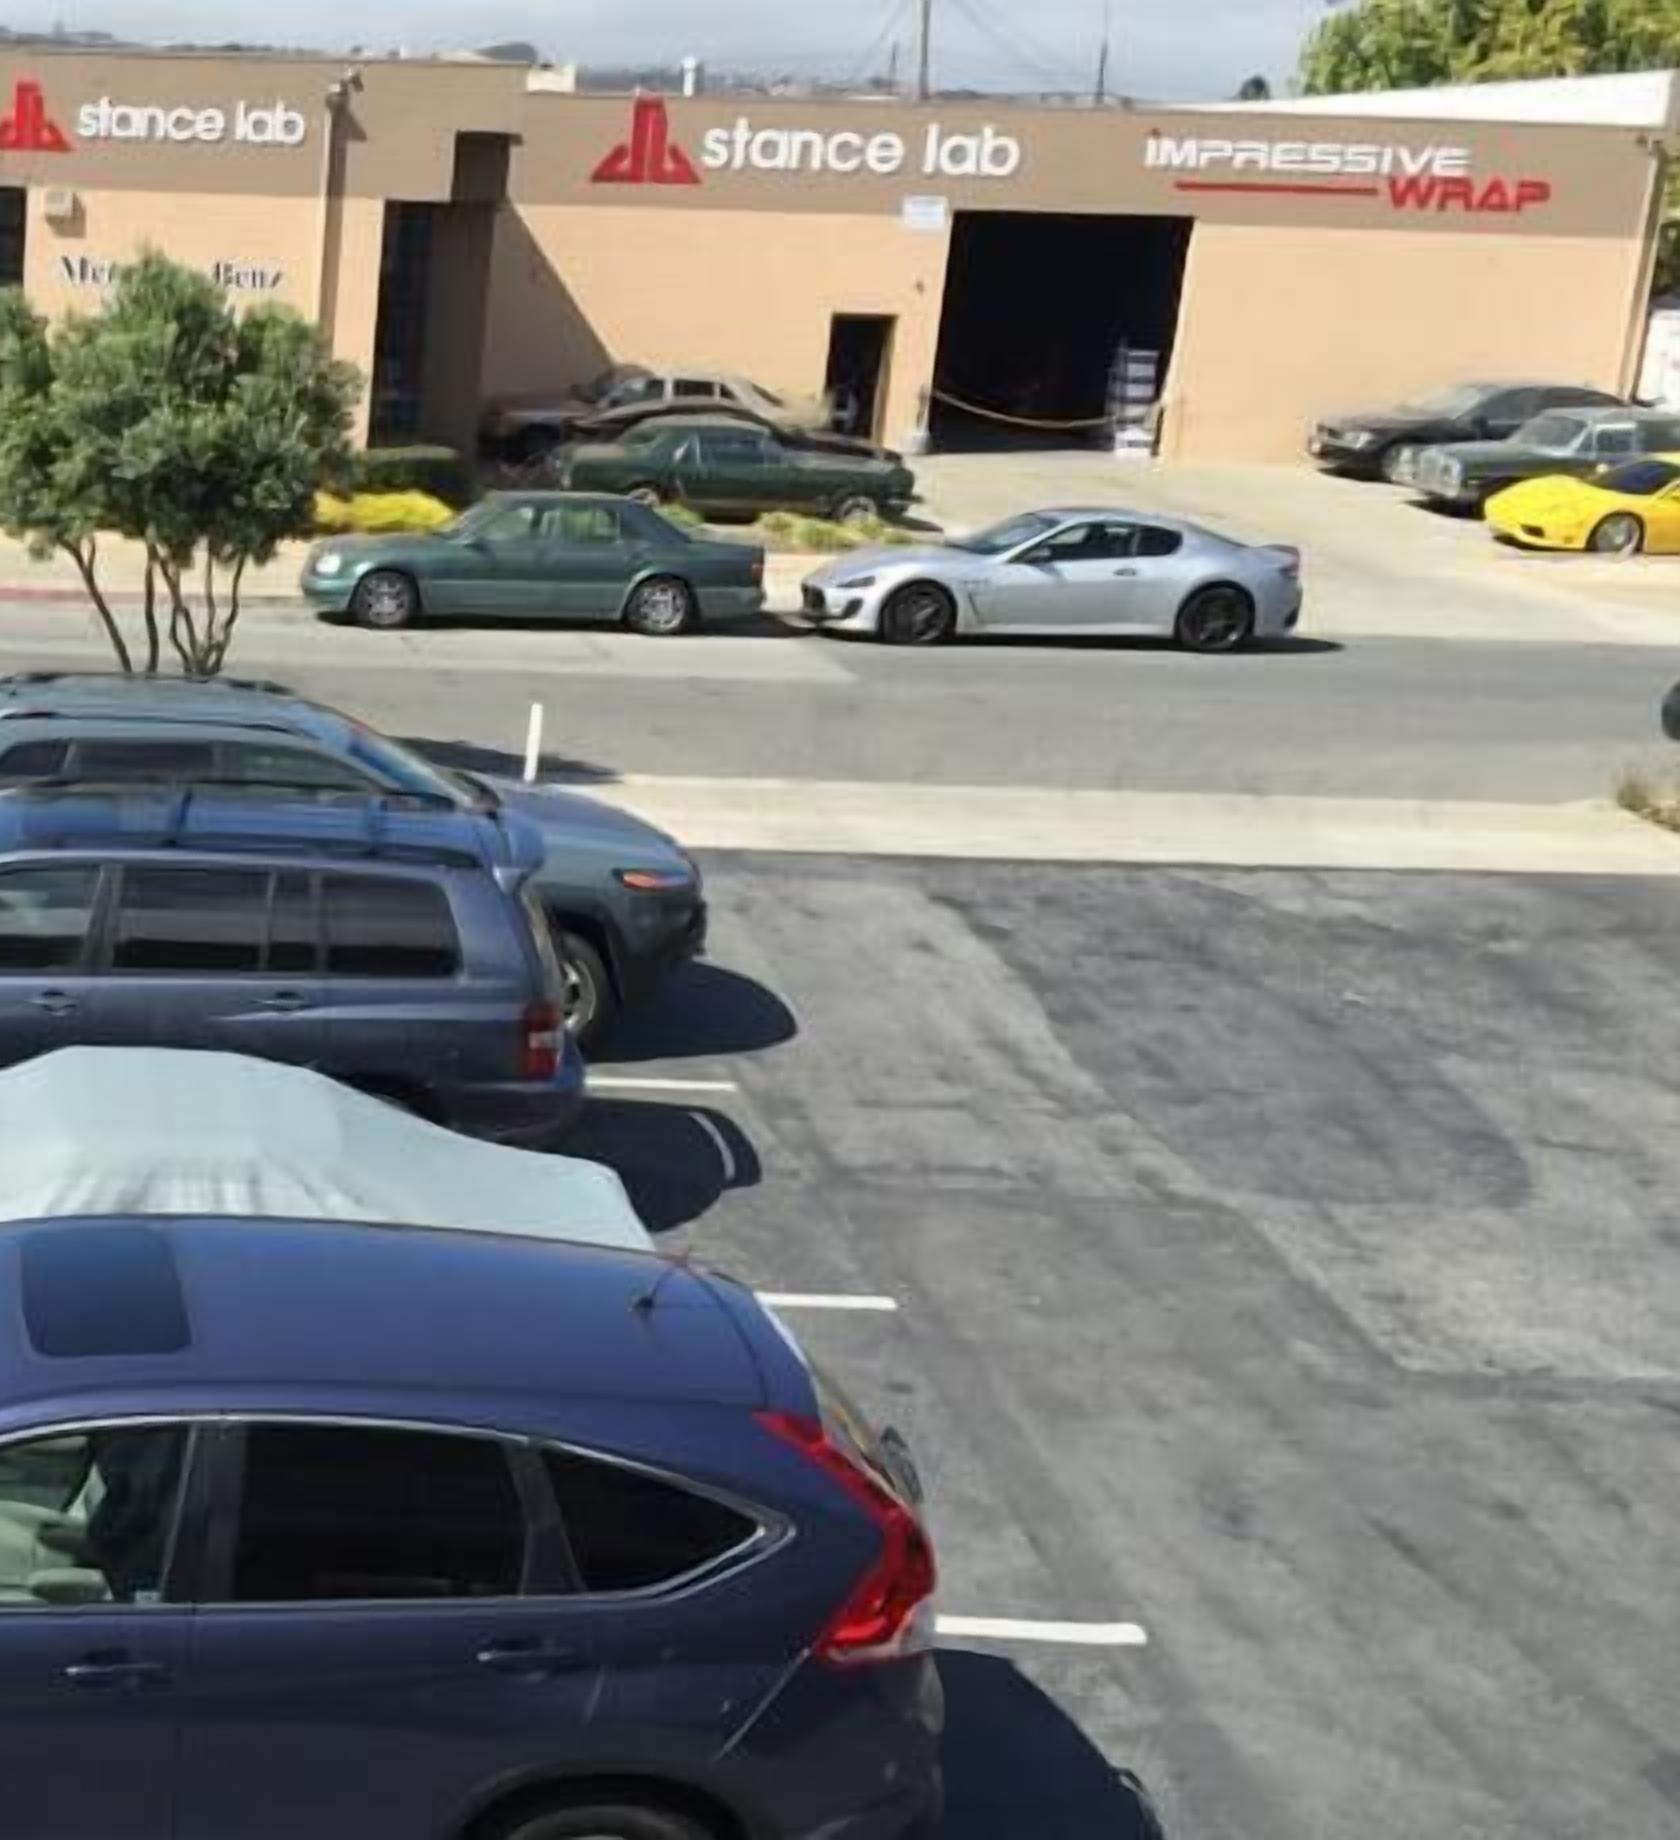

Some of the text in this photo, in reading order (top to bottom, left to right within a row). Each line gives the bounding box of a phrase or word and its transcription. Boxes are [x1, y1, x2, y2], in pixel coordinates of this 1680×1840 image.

[78, 96, 305, 144] stance lab
[701, 117, 1020, 176] stance lab
[1144, 137, 1472, 177] IMPRESSIVE
[1389, 177, 1551, 213] WRAP
